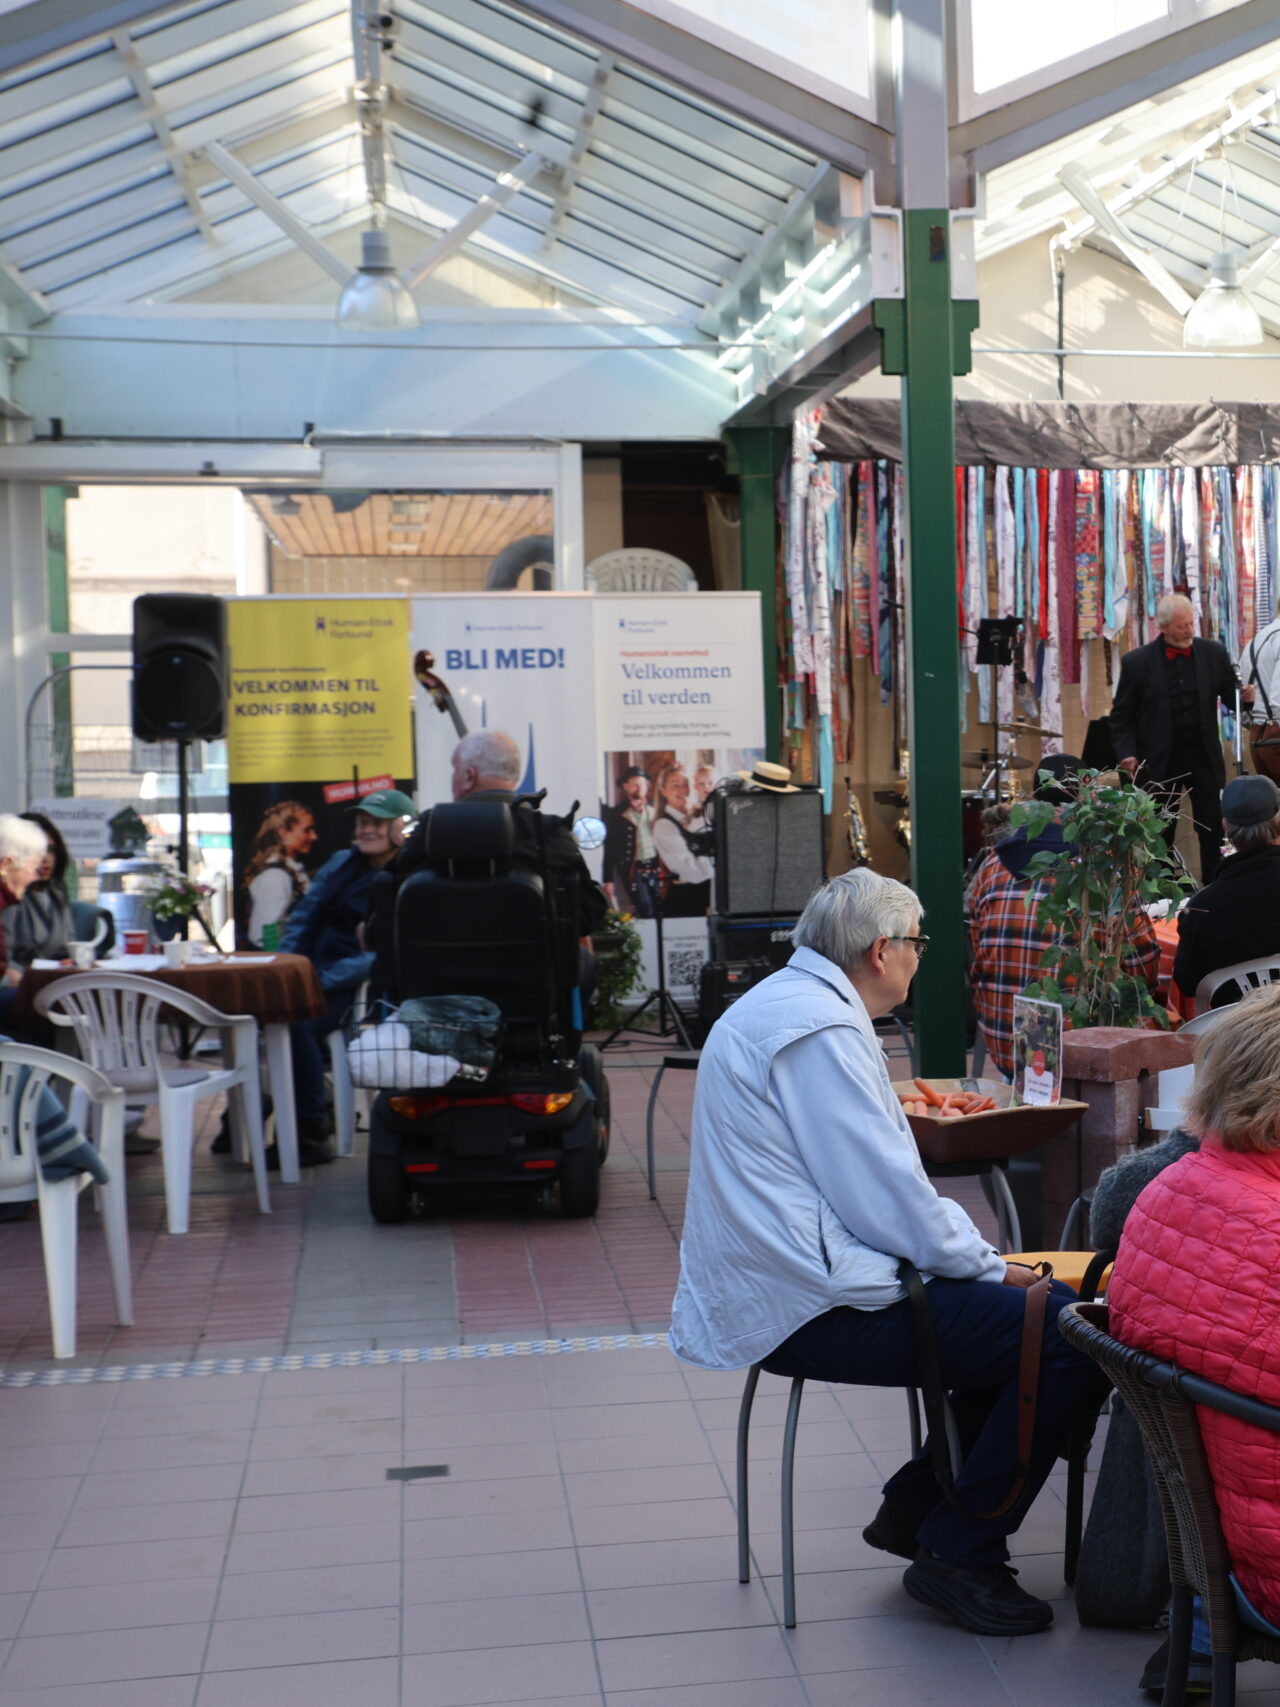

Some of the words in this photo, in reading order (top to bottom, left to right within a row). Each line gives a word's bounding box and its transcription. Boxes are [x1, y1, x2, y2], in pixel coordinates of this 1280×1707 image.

[446, 649, 488, 670] BLI
[496, 648, 565, 669] MED!
[621, 663, 732, 680] Velkommen
[233, 679, 350, 694] VELKOMMEN
[355, 679, 380, 692] TIL
[622, 689, 643, 705] til
[648, 688, 712, 705] verden
[235, 701, 376, 717] KONFIRMASJON
